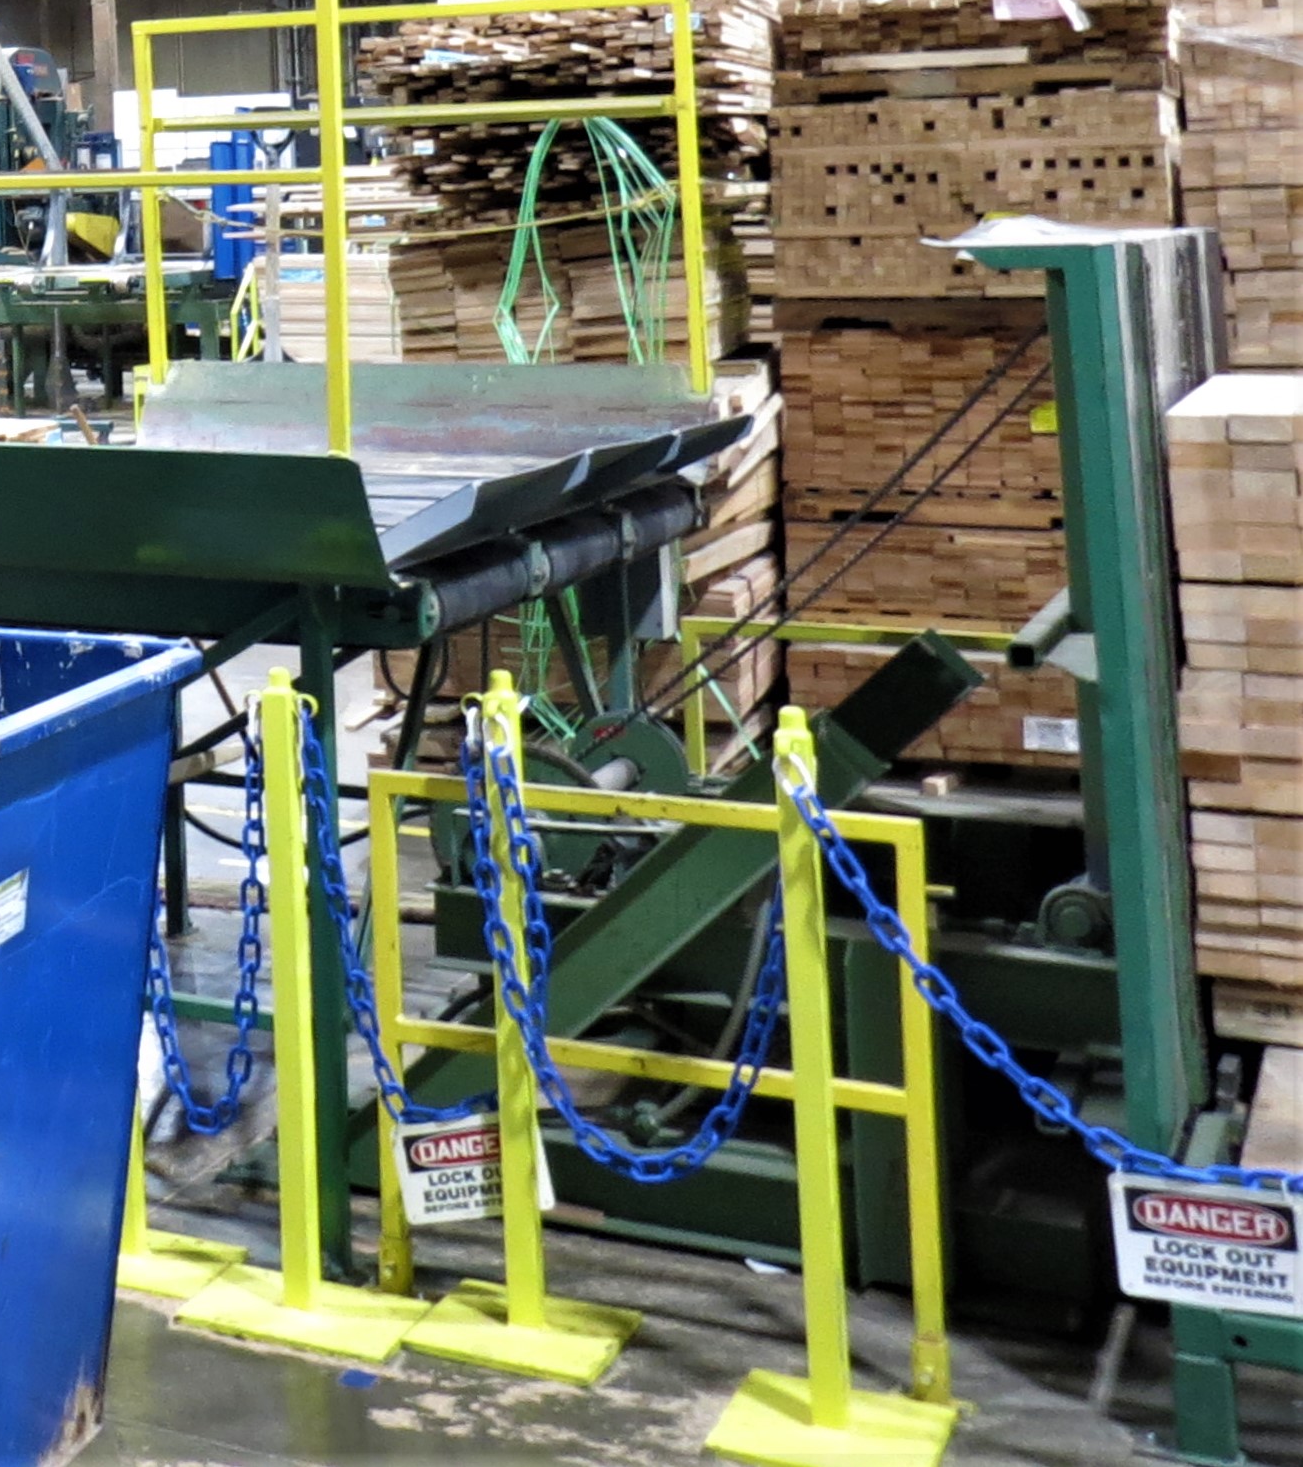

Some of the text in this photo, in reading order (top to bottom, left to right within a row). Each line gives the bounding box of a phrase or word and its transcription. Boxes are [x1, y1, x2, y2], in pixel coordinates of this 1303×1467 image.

[419, 1133, 501, 1163] DANGE
[428, 1166, 502, 1186] LOCK OU
[1144, 1200, 1277, 1239] DANGER
[1153, 1238, 1276, 1268] LOCK OUT
[1145, 1256, 1288, 1288] EQUIPMENT
